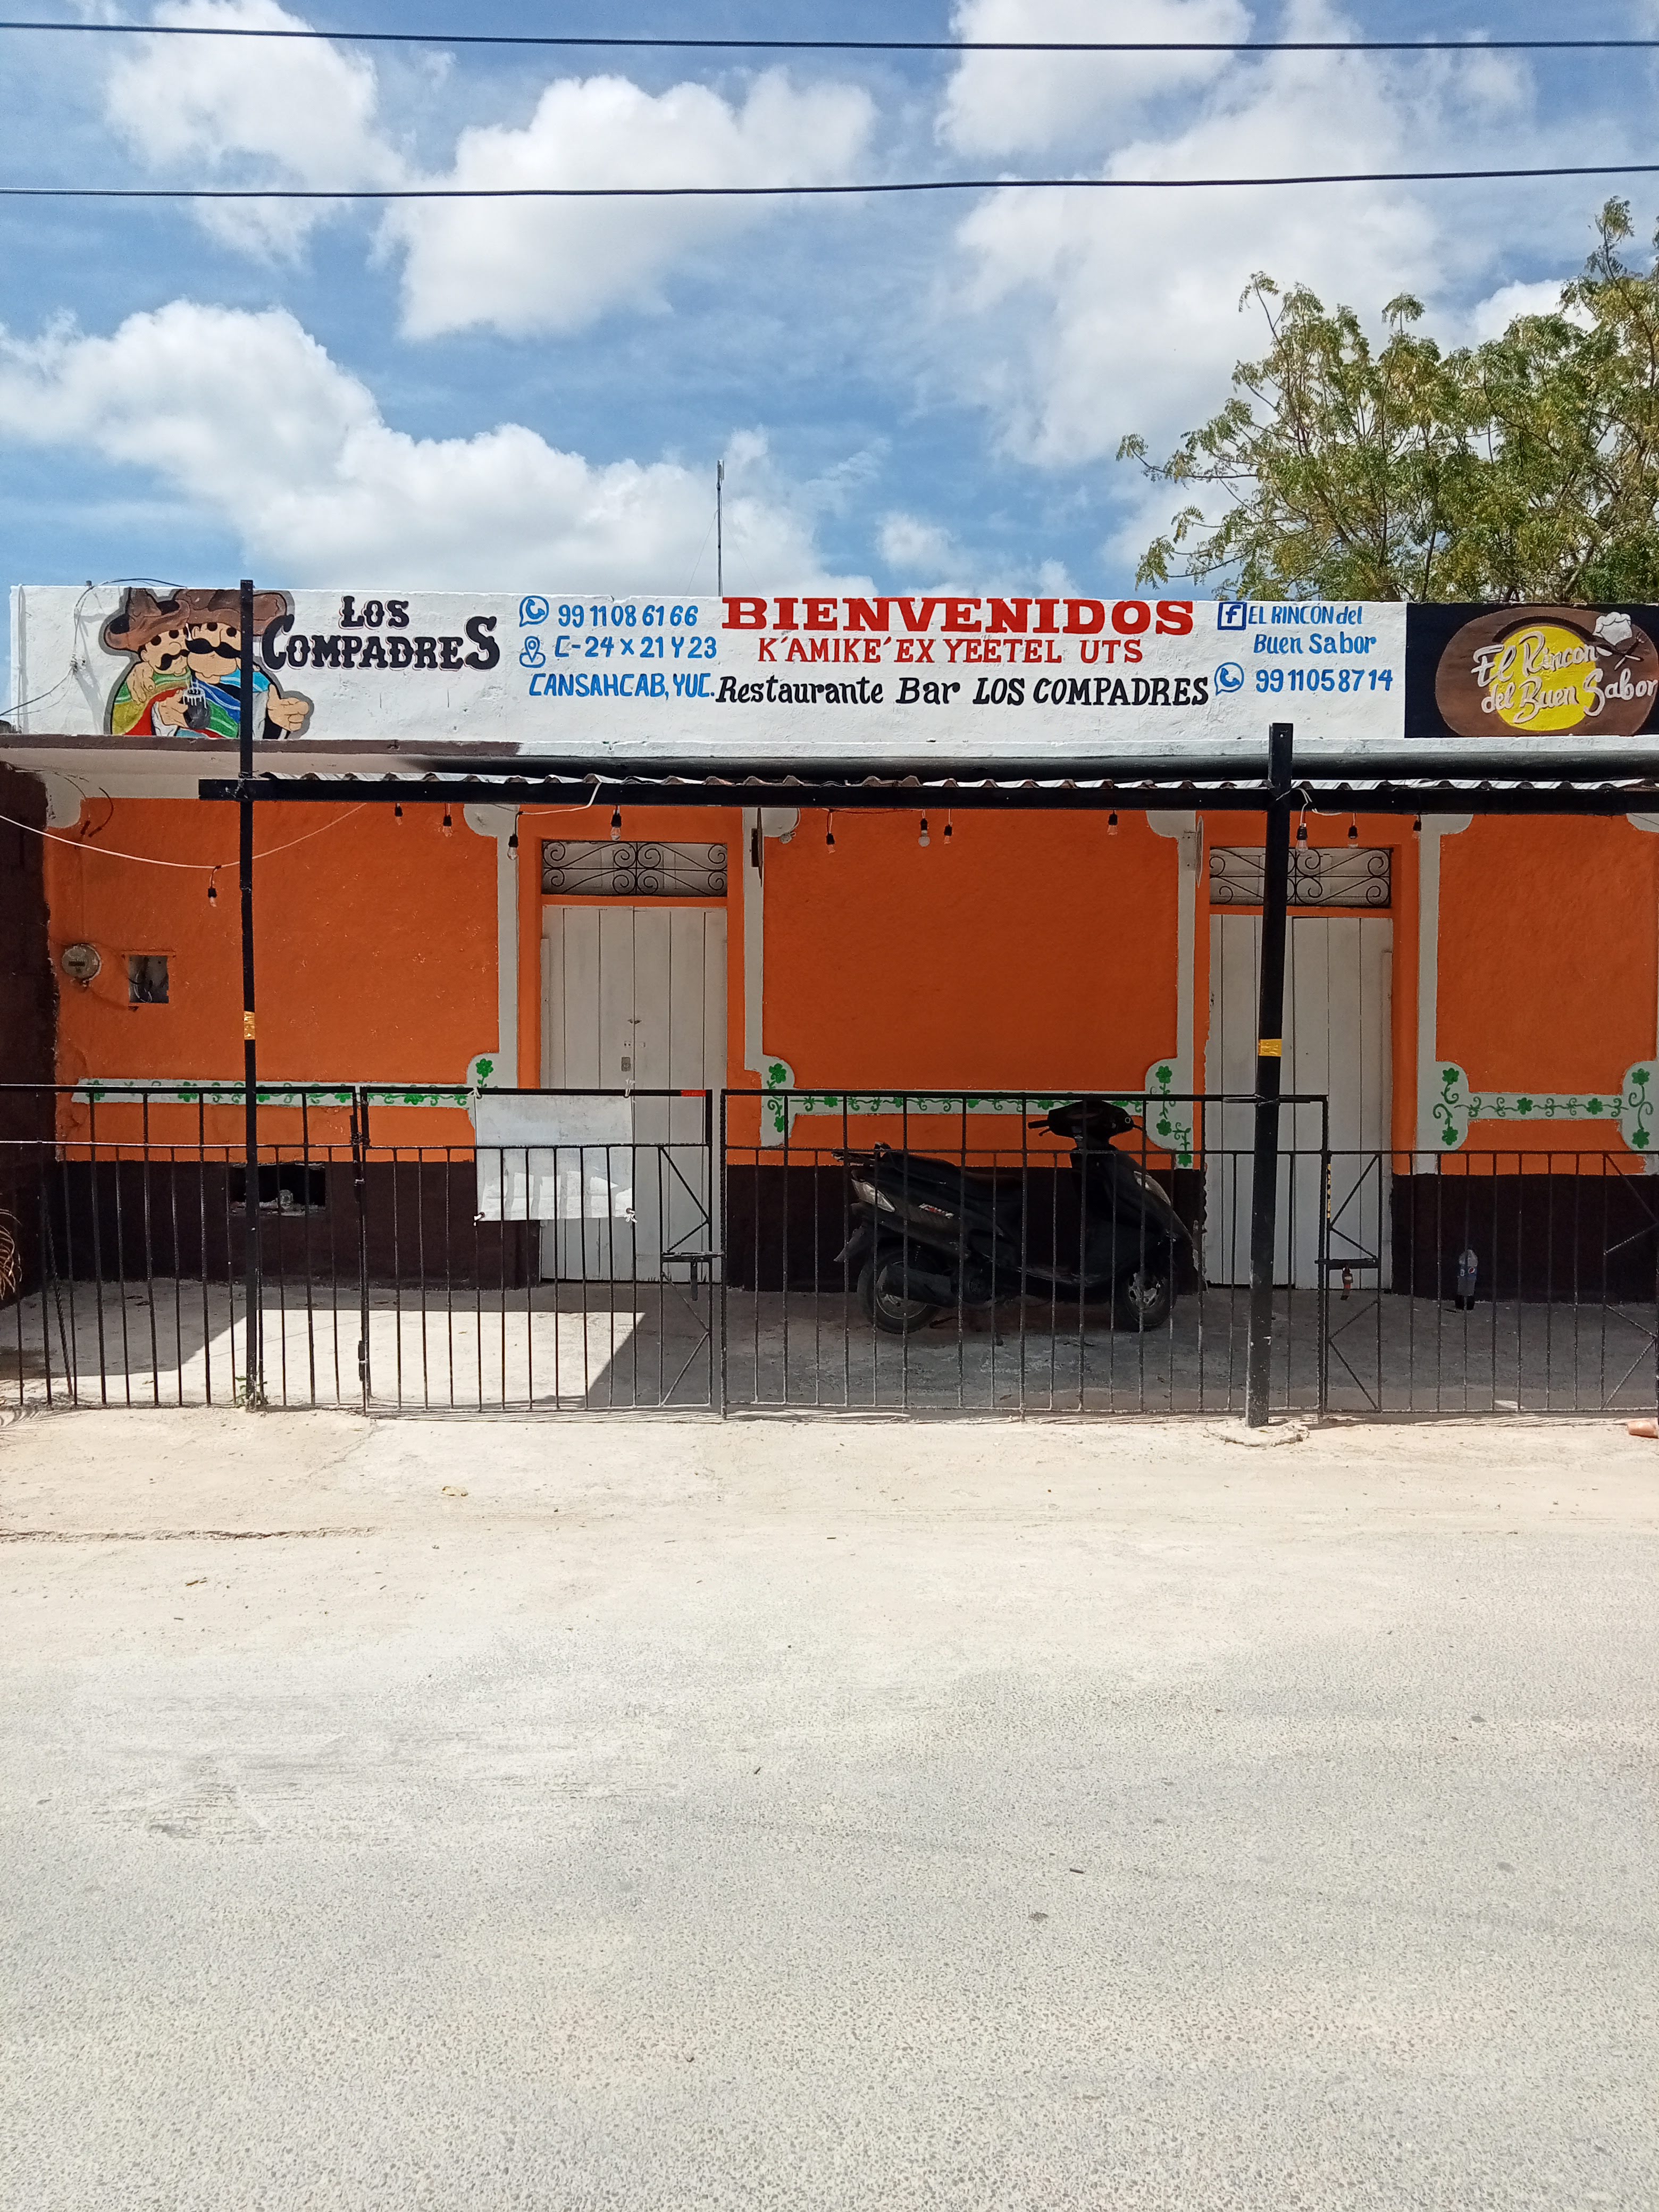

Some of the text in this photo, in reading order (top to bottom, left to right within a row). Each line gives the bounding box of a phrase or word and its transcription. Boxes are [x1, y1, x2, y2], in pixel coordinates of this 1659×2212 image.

[341, 596, 409, 628] LOS
[722, 597, 1194, 635] BIENVENIDOS
[1248, 606, 1267, 624] EL
[1336, 606, 1362, 625] del
[260, 614, 500, 671] COMPADRES
[639, 636, 664, 658] 21
[671, 636, 685, 659] Y
[687, 636, 717, 659] 23
[942, 639, 1062, 663] YEETEL
[1080, 639, 1143, 664] UTS
[1253, 632, 1377, 654] Buen Sabor
[1471, 631, 1598, 688] El Rincon
[529, 673, 715, 700] CANSAHCAB, YUC.
[715, 674, 1209, 706] Restaurante Bar LOS COMPADRES
[1481, 667, 1658, 724] del Buen Sabor
